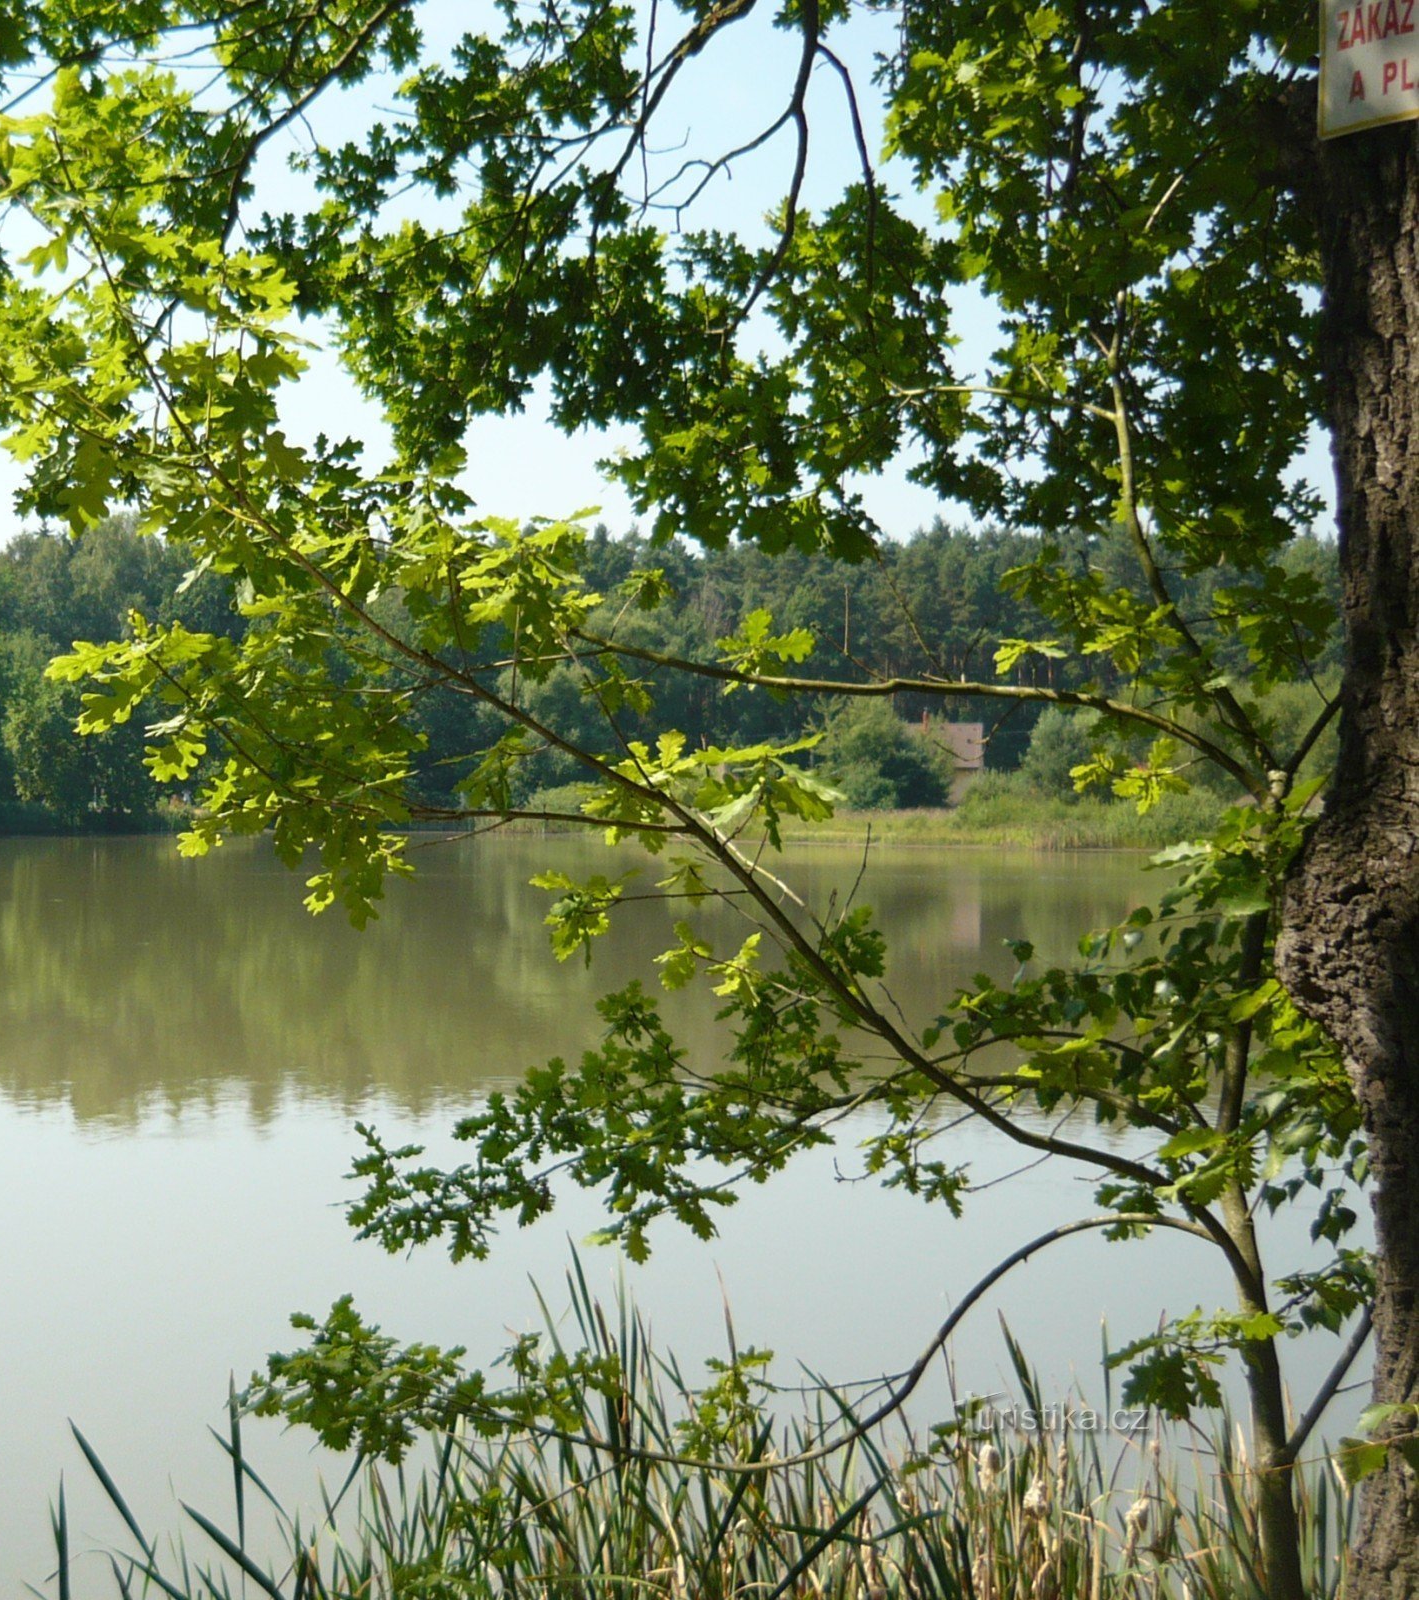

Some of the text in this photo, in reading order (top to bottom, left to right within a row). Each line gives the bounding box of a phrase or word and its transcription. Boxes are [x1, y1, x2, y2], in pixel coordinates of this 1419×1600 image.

[1337, 0, 1414, 51] ZÁKAZ
[1350, 59, 1419, 102] A PL
